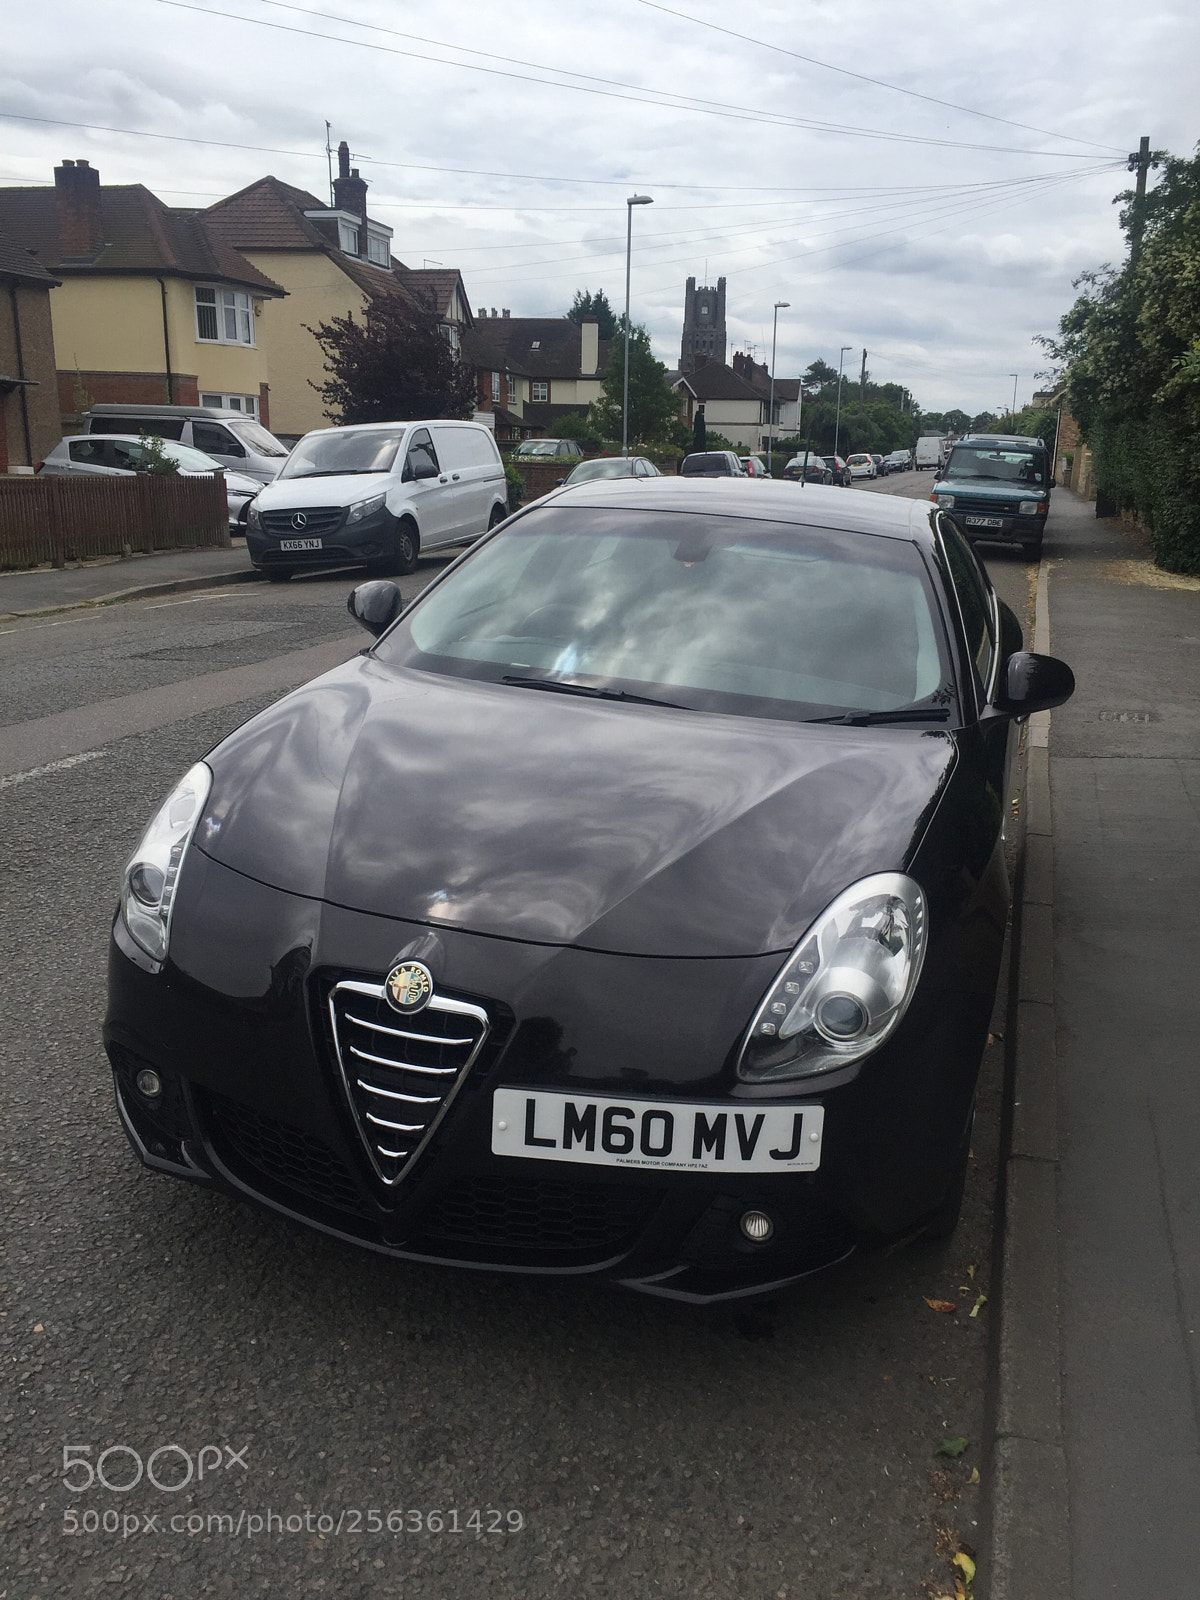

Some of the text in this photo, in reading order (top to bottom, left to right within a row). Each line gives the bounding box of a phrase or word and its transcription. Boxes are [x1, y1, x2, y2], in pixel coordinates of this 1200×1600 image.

[966, 517, 986, 525] R377
[283, 540, 320, 549] KX66 YNJ
[388, 966, 429, 993] ALFA ROMEO
[524, 1098, 804, 1161] LM60 MVJ
